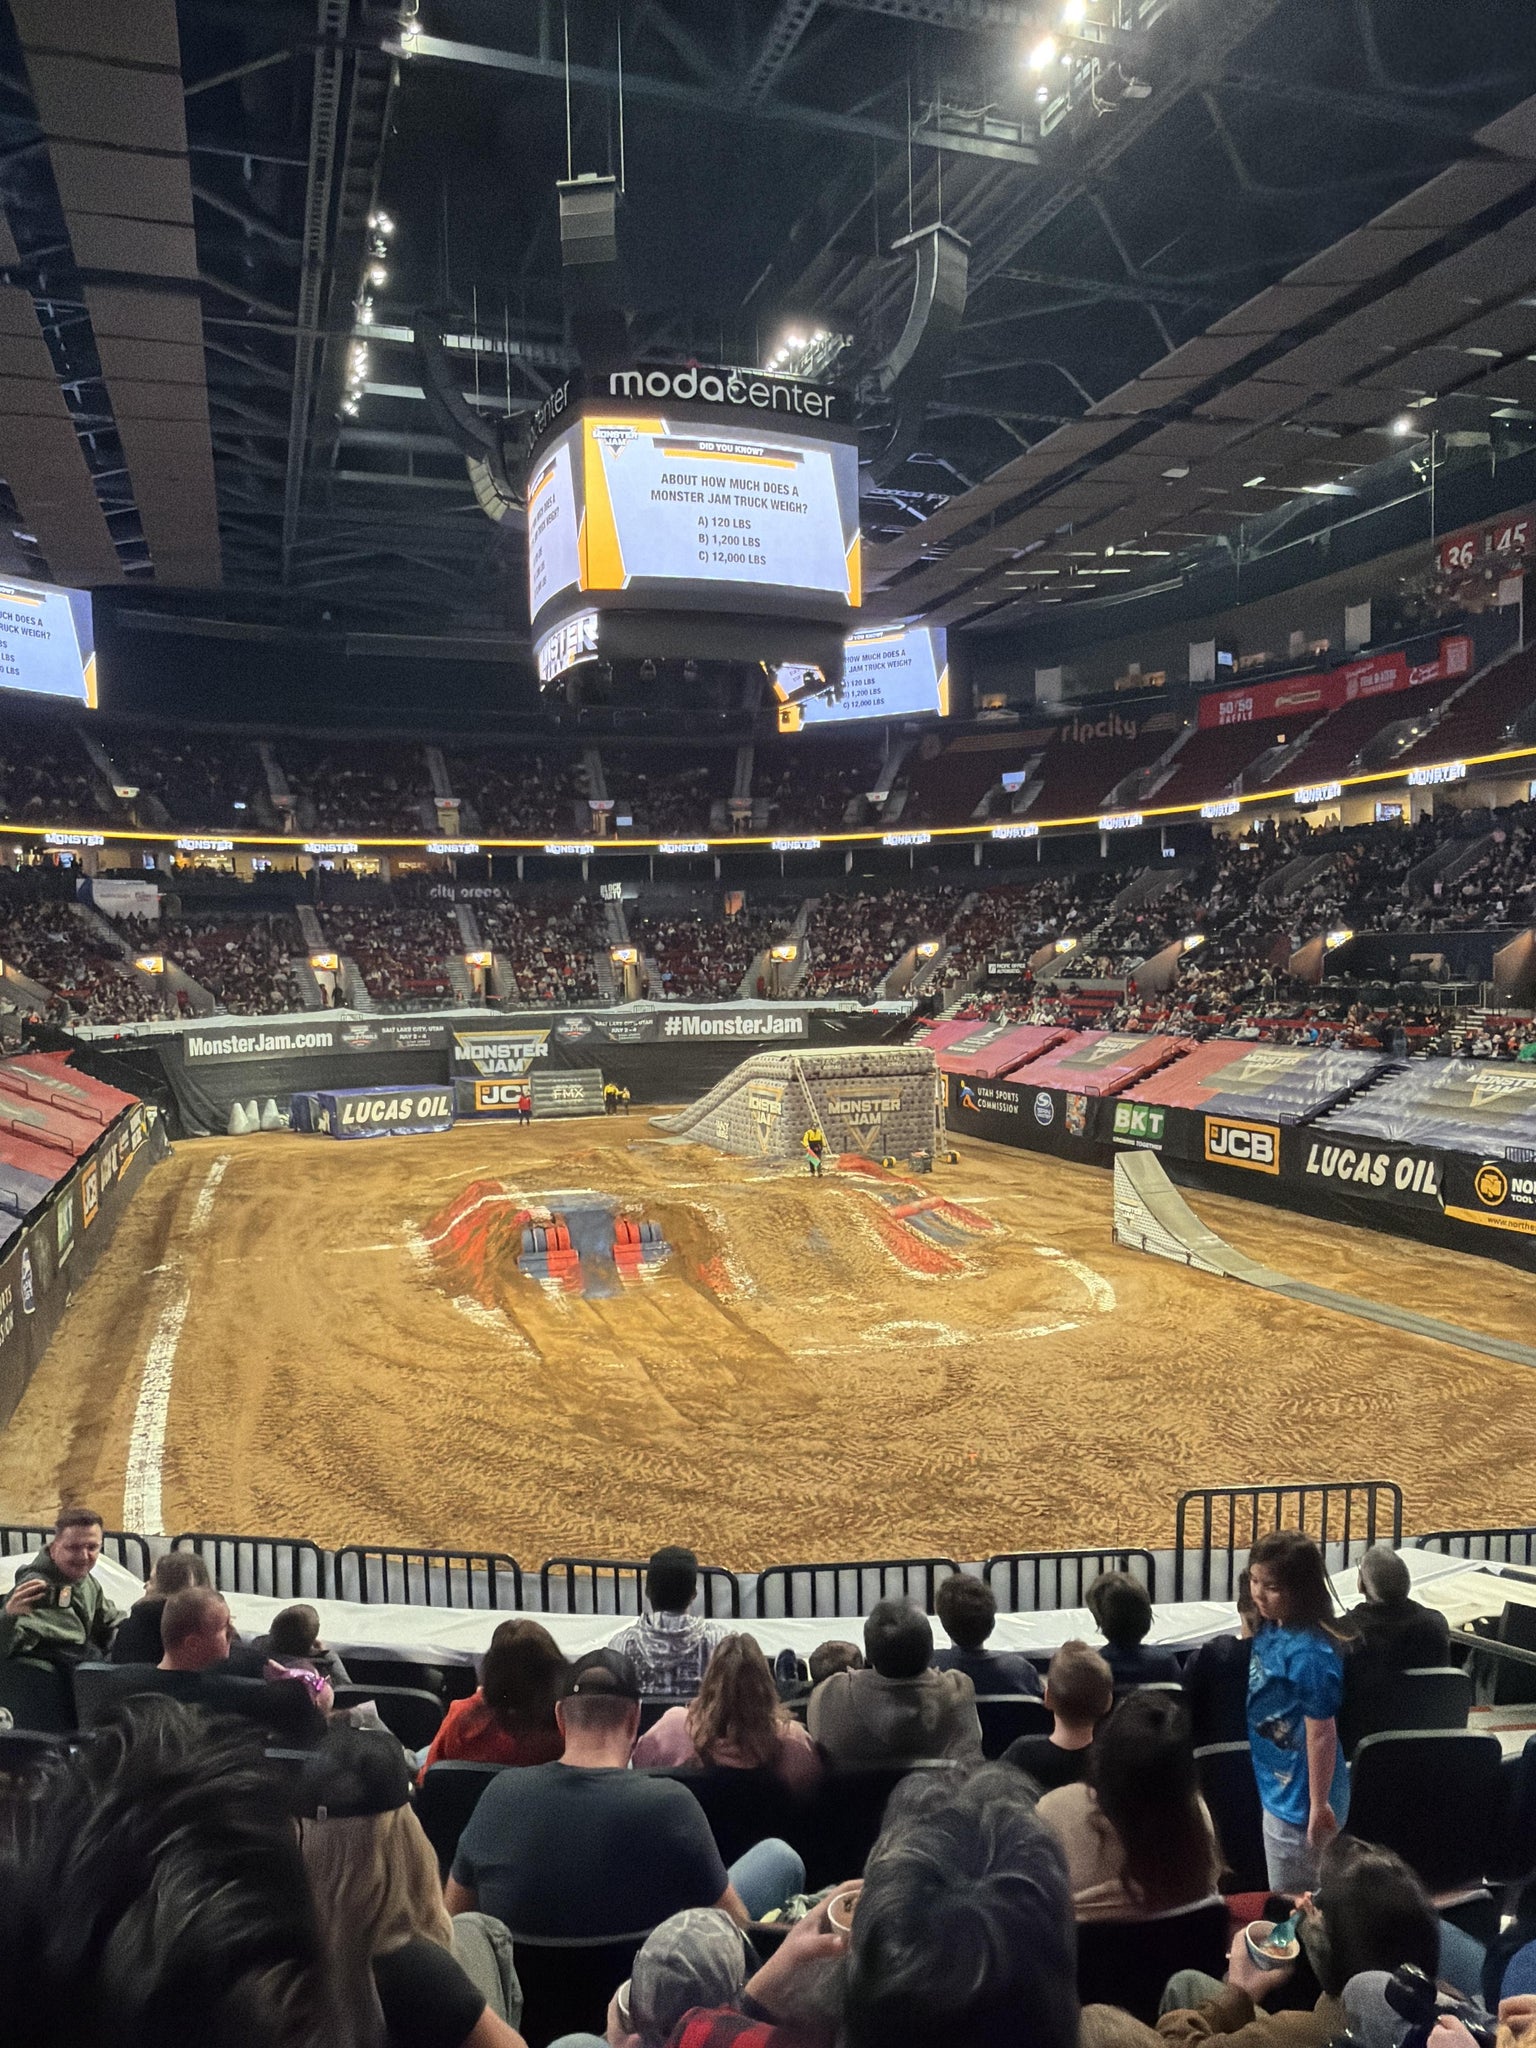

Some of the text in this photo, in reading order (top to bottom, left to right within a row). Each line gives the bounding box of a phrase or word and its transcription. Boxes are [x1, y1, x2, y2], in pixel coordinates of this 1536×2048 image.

[592, 429, 639, 440] MONSTER
[604, 438, 626, 446] JAM
[699, 442, 764, 455] DID YOU KNOW?
[661, 473, 799, 497] ABOUT HOW MUCH DOES A
[651, 490, 808, 514] MONSTER JAM TRUCK WEIGH?
[698, 516, 751, 529] A) 120 LBS
[698, 533, 761, 547] B) 1,200 LBS
[698, 551, 766, 565] C) 12,000 LBS
[15, 614, 36, 625] DOES
[21, 628, 51, 639] WEIGH?
[1, 653, 15, 662] LBS
[862, 652, 881, 662] MUCH
[883, 650, 900, 659] DOES
[6, 666, 20, 675] LBS
[849, 659, 912, 673] JAM TRUCK WEIGH?
[851, 679, 862, 687] 120
[851, 689, 868, 698] 1,200
[851, 700, 872, 709] 12,000
[873, 698, 885, 706] LBS
[1219, 711, 1253, 725] RAFFLE
[430, 885, 455, 901] city
[600, 882, 622, 893] BLOCK
[664, 1014, 803, 1036] #MonsterJam
[188, 1030, 333, 1057] MonsterJam.com
[454, 1043, 549, 1060] MONSTER
[483, 1058, 524, 1073] JAM
[553, 1088, 584, 1099] FMX
[977, 1087, 1019, 1102] UTAH SPORTS
[342, 1096, 451, 1125] LUCAS OIL
[828, 1099, 901, 1115] MONSTER
[977, 1098, 1019, 1114] COMMISSION
[849, 1112, 881, 1125] JAM
[1115, 1107, 1164, 1134] BKT
[1210, 1126, 1274, 1163] JCB
[1306, 1143, 1438, 1195] LUCAS OIL
[1511, 1194, 1534, 1204] TOOL
